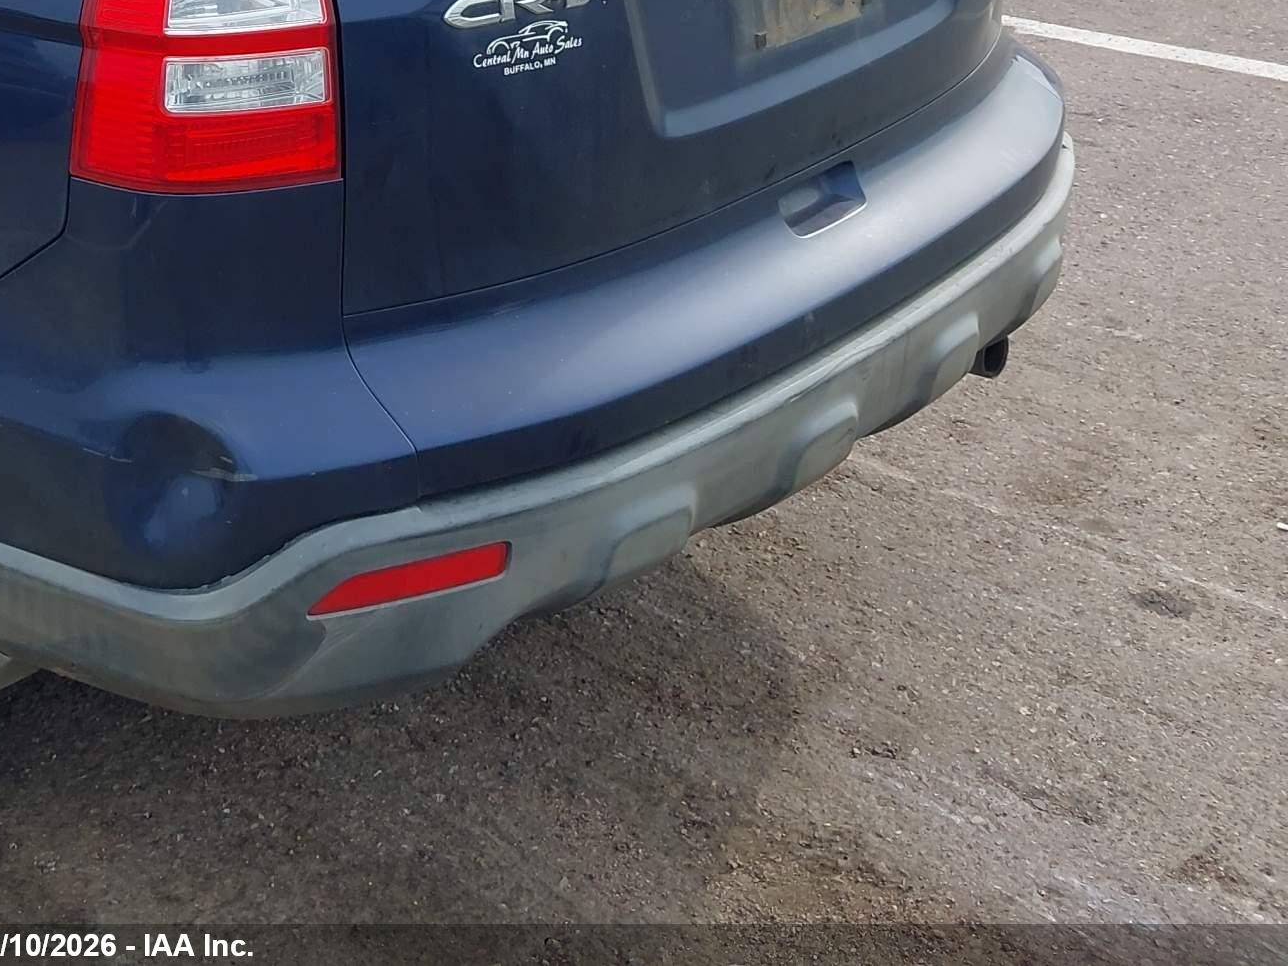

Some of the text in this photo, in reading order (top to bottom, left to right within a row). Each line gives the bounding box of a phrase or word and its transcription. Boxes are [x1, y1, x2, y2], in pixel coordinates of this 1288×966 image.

[473, 52, 511, 68] Central
[531, 41, 553, 59] Auto
[554, 36, 583, 54] Sales
[503, 57, 556, 76] BUFFALO, MN
